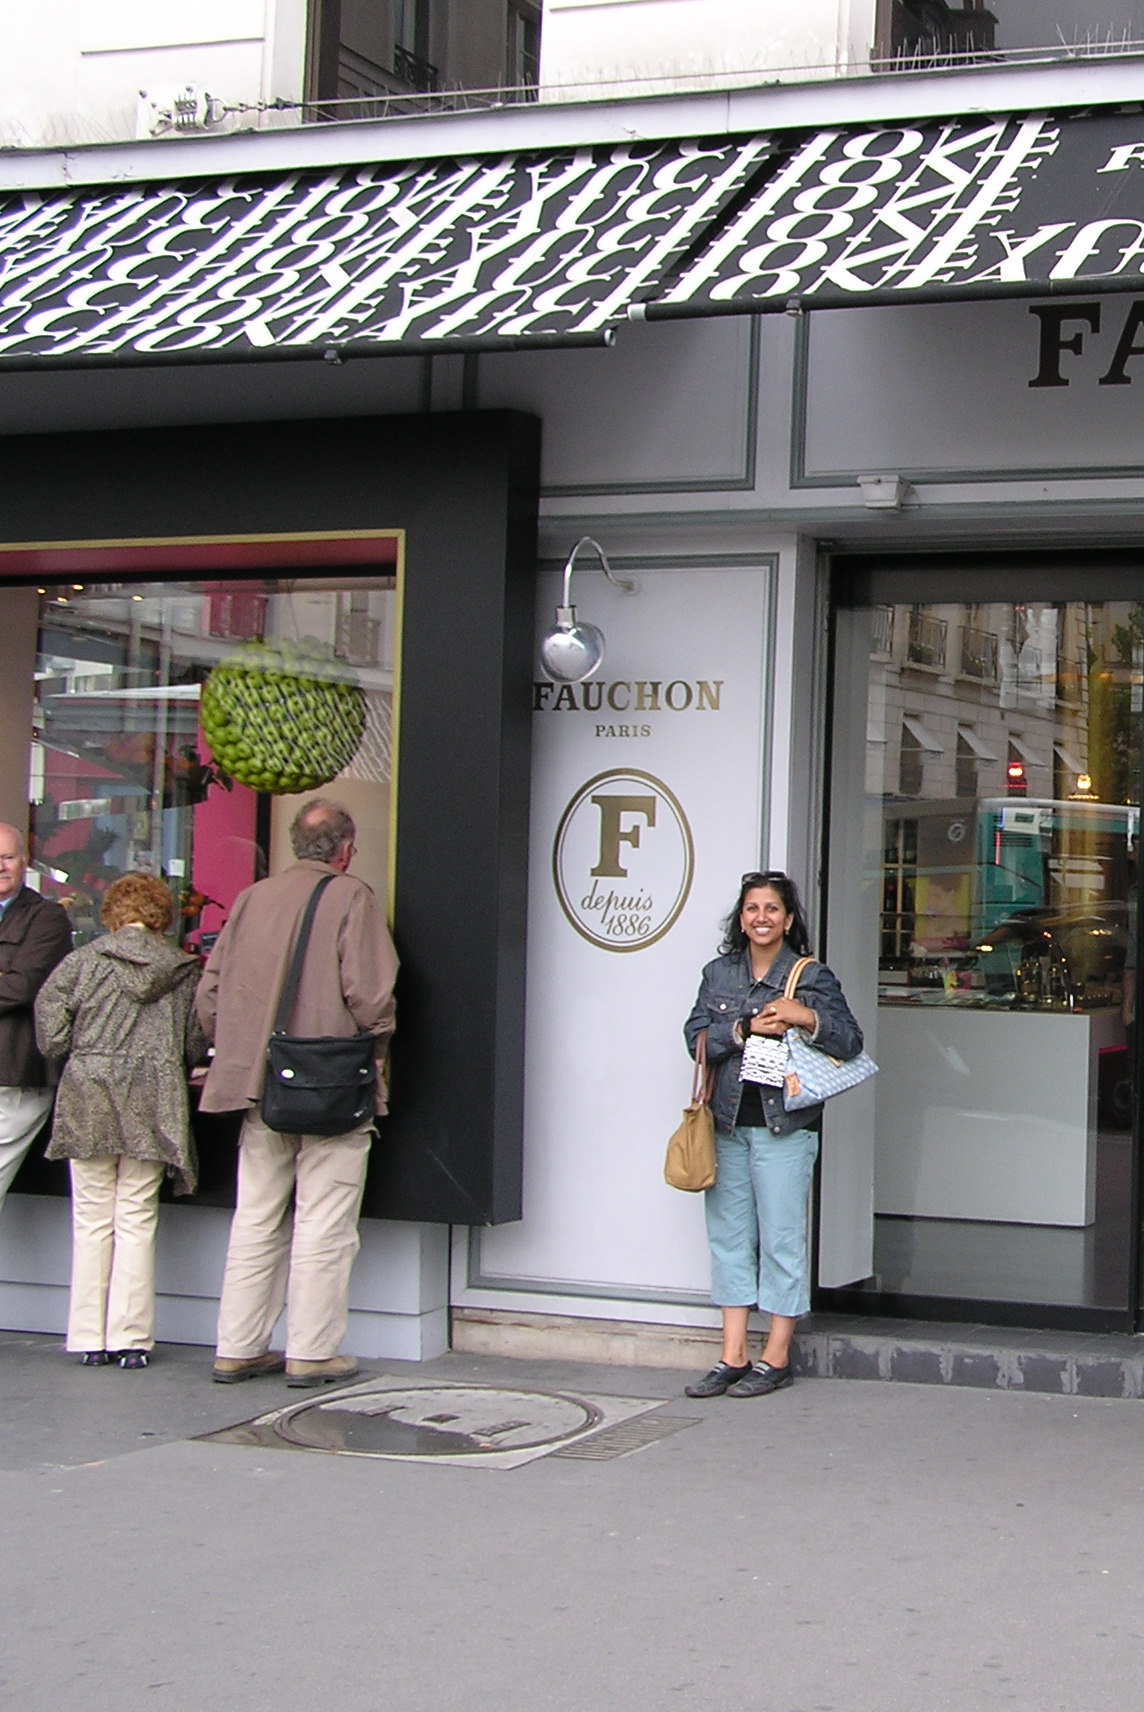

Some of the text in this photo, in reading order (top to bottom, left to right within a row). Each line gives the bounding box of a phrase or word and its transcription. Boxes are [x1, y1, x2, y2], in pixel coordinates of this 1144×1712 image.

[532, 680, 724, 711] FAUCHON
[594, 724, 652, 738] PARIS
[590, 794, 657, 878] F
[580, 879, 653, 923] depuis
[604, 913, 652, 936] 1886
